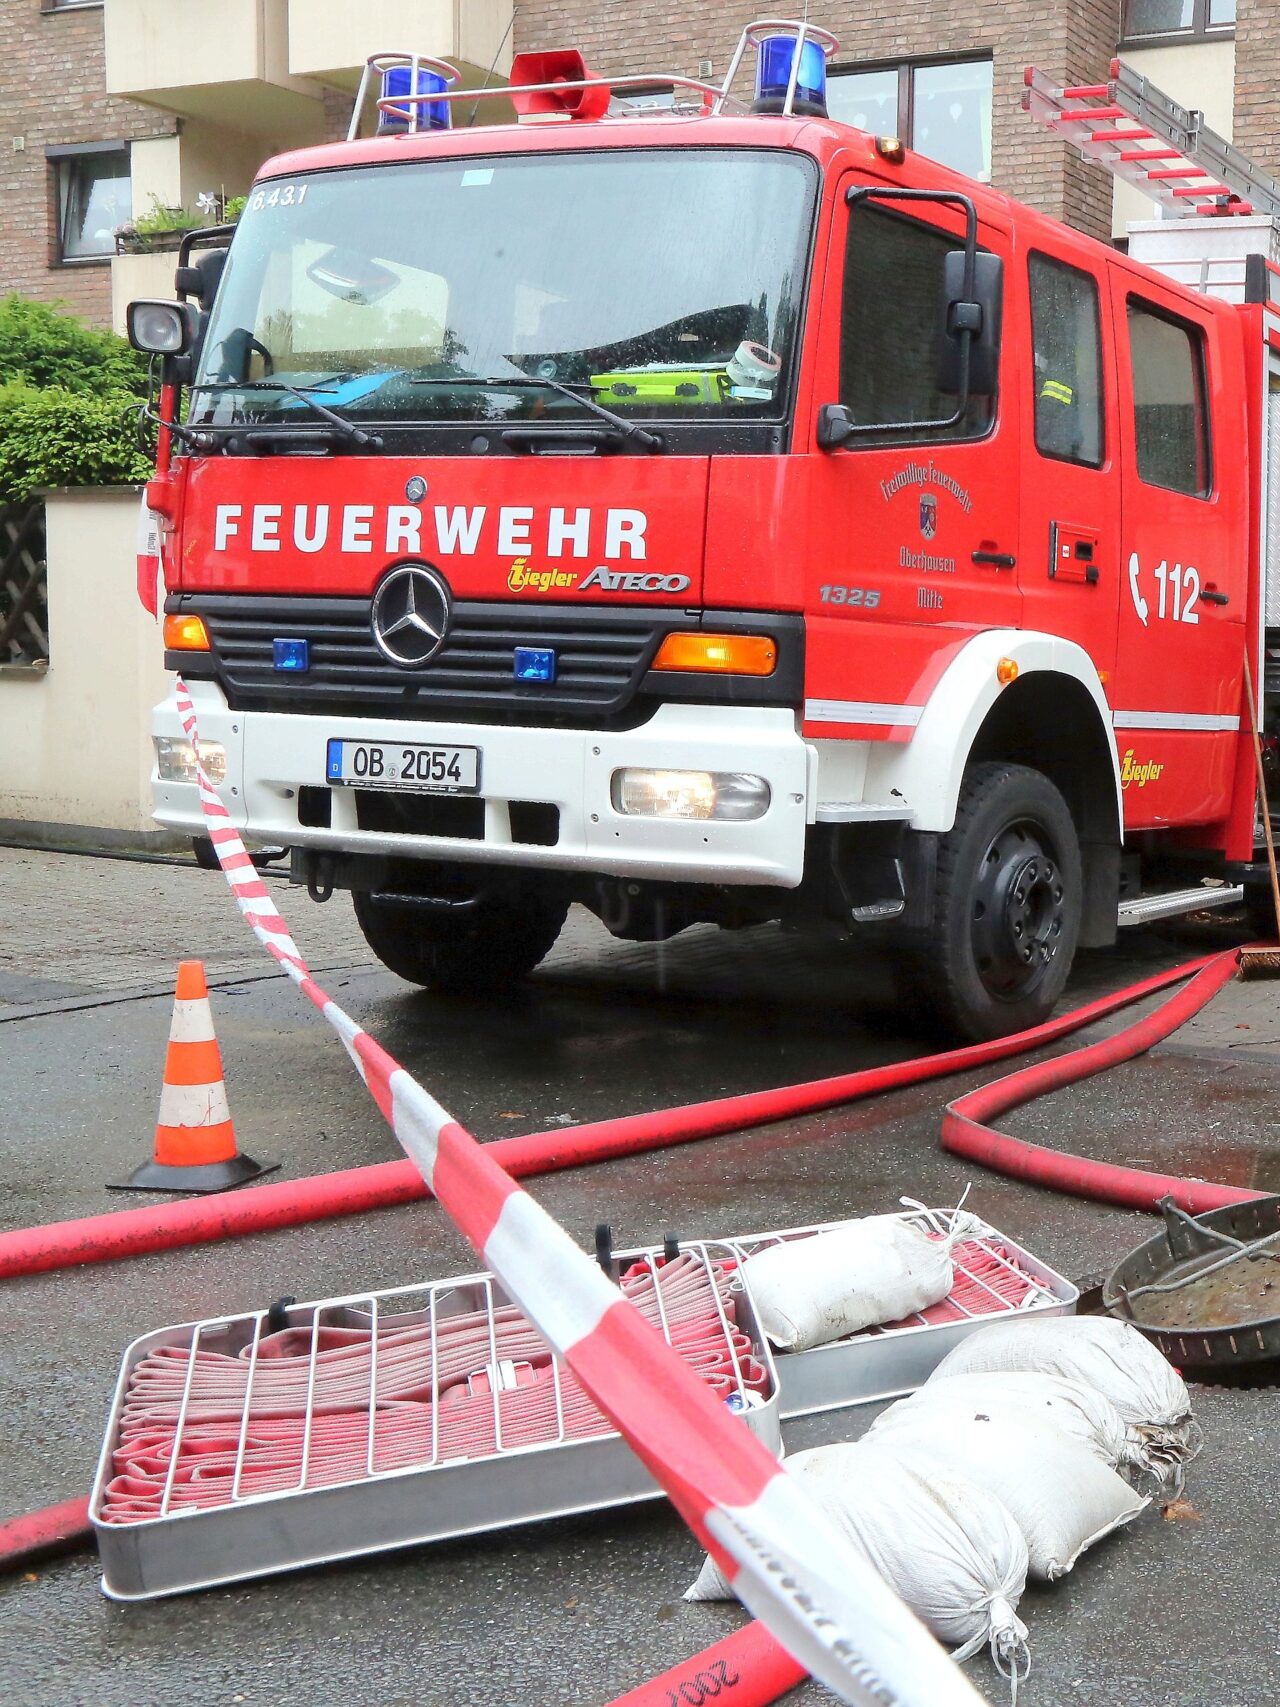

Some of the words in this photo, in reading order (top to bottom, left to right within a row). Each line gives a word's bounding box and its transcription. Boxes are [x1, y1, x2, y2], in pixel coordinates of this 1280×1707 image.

[880, 462, 928, 502] Freiwillige
[928, 460, 973, 513] Feuerwehr
[213, 504, 648, 560] FEUERWEHR
[507, 557, 578, 593] Ziegler
[899, 546, 955, 573] Oberhausen
[820, 584, 880, 608] 1325
[917, 586, 943, 609] Mitte
[1154, 560, 1200, 625] 112
[353, 747, 384, 777] OB
[401, 749, 461, 782] 2054
[1120, 748, 1164, 790] Ziegler
